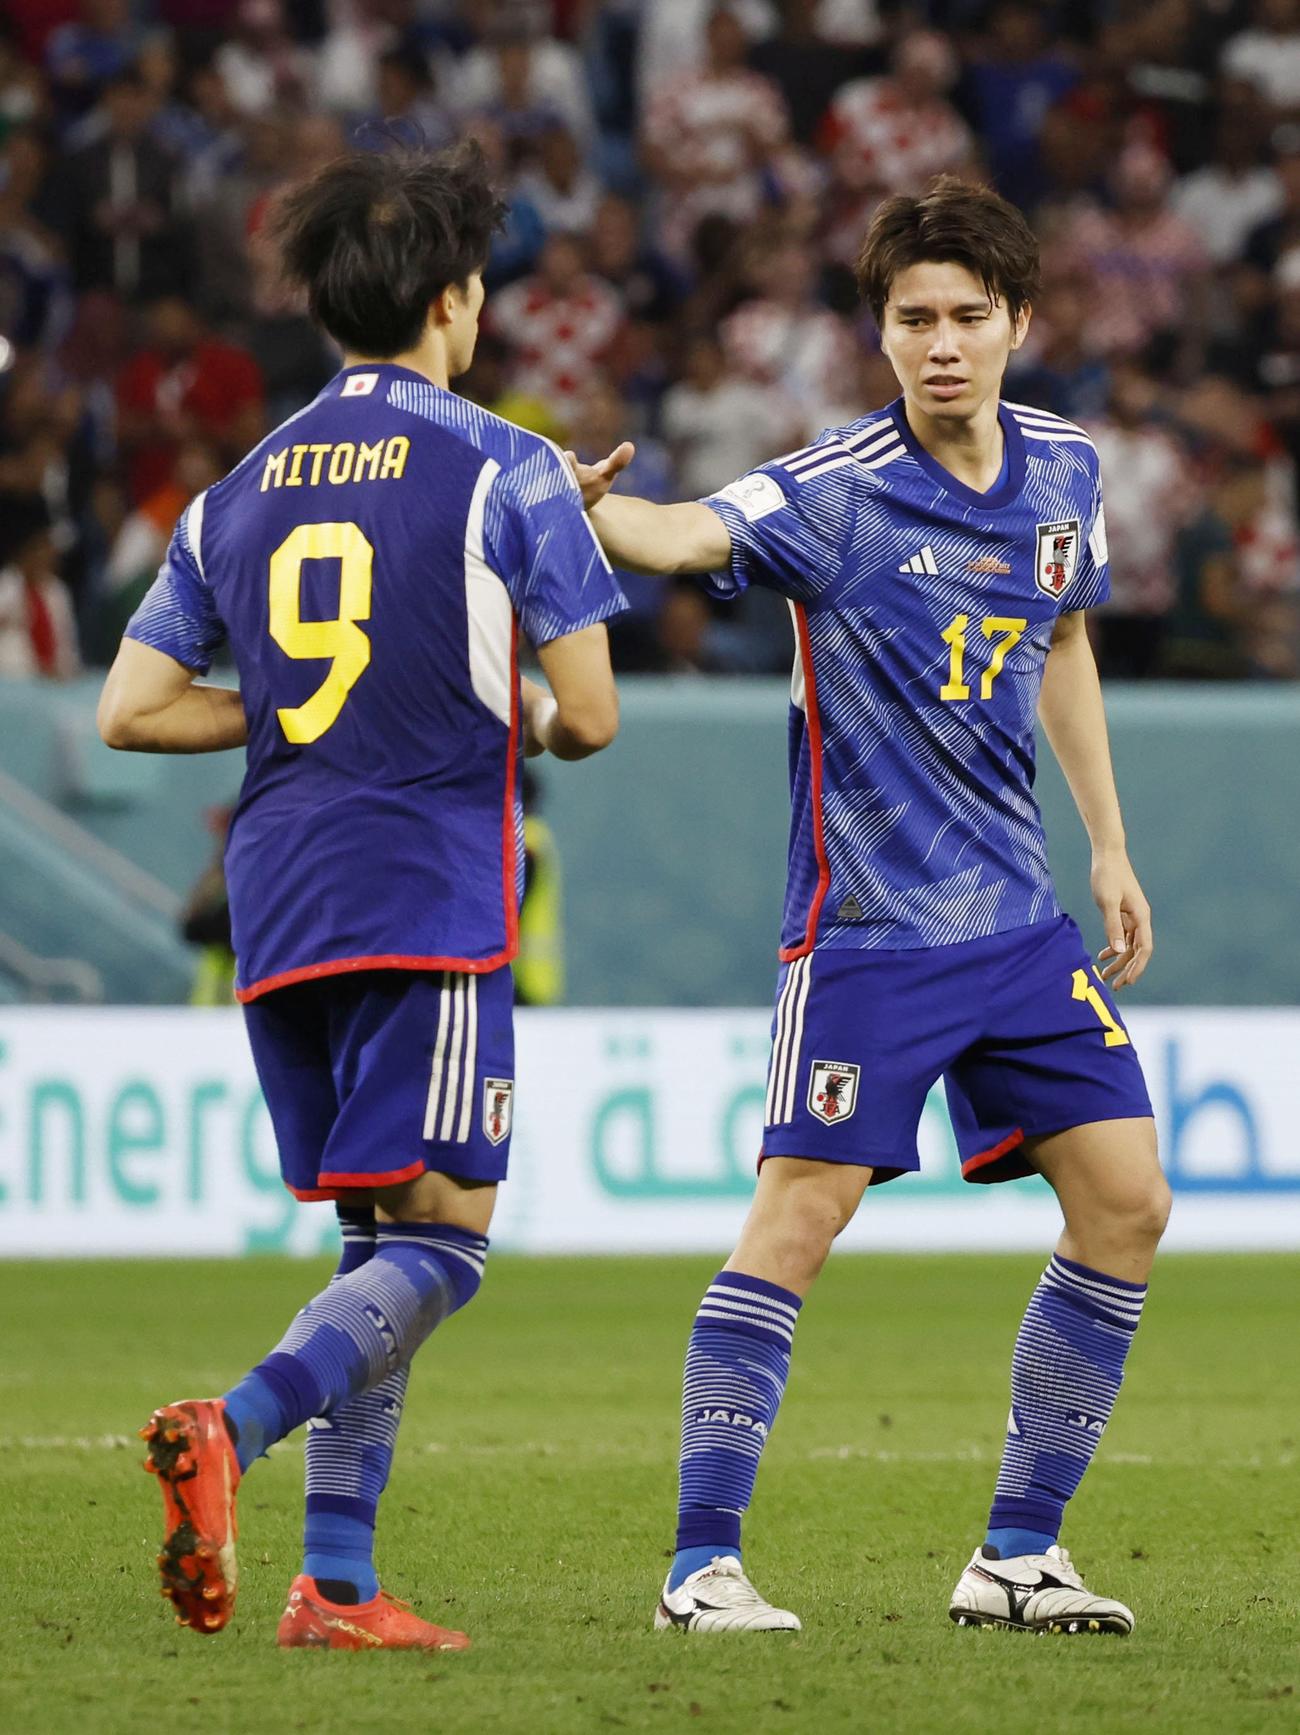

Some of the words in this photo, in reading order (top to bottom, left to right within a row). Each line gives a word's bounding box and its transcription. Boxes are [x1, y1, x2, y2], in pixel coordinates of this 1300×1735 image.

[260, 436, 410, 492] MITOMA
[1048, 523, 1070, 533] JAPAN
[268, 521, 374, 744] 9
[940, 614, 1027, 700] 17
[1070, 964, 1130, 1048] 1
[823, 1063, 849, 1072] JAPAN
[0, 1040, 342, 1255] nerg
[696, 1409, 769, 1441] JAPA
[1068, 1414, 1107, 1435] JA
